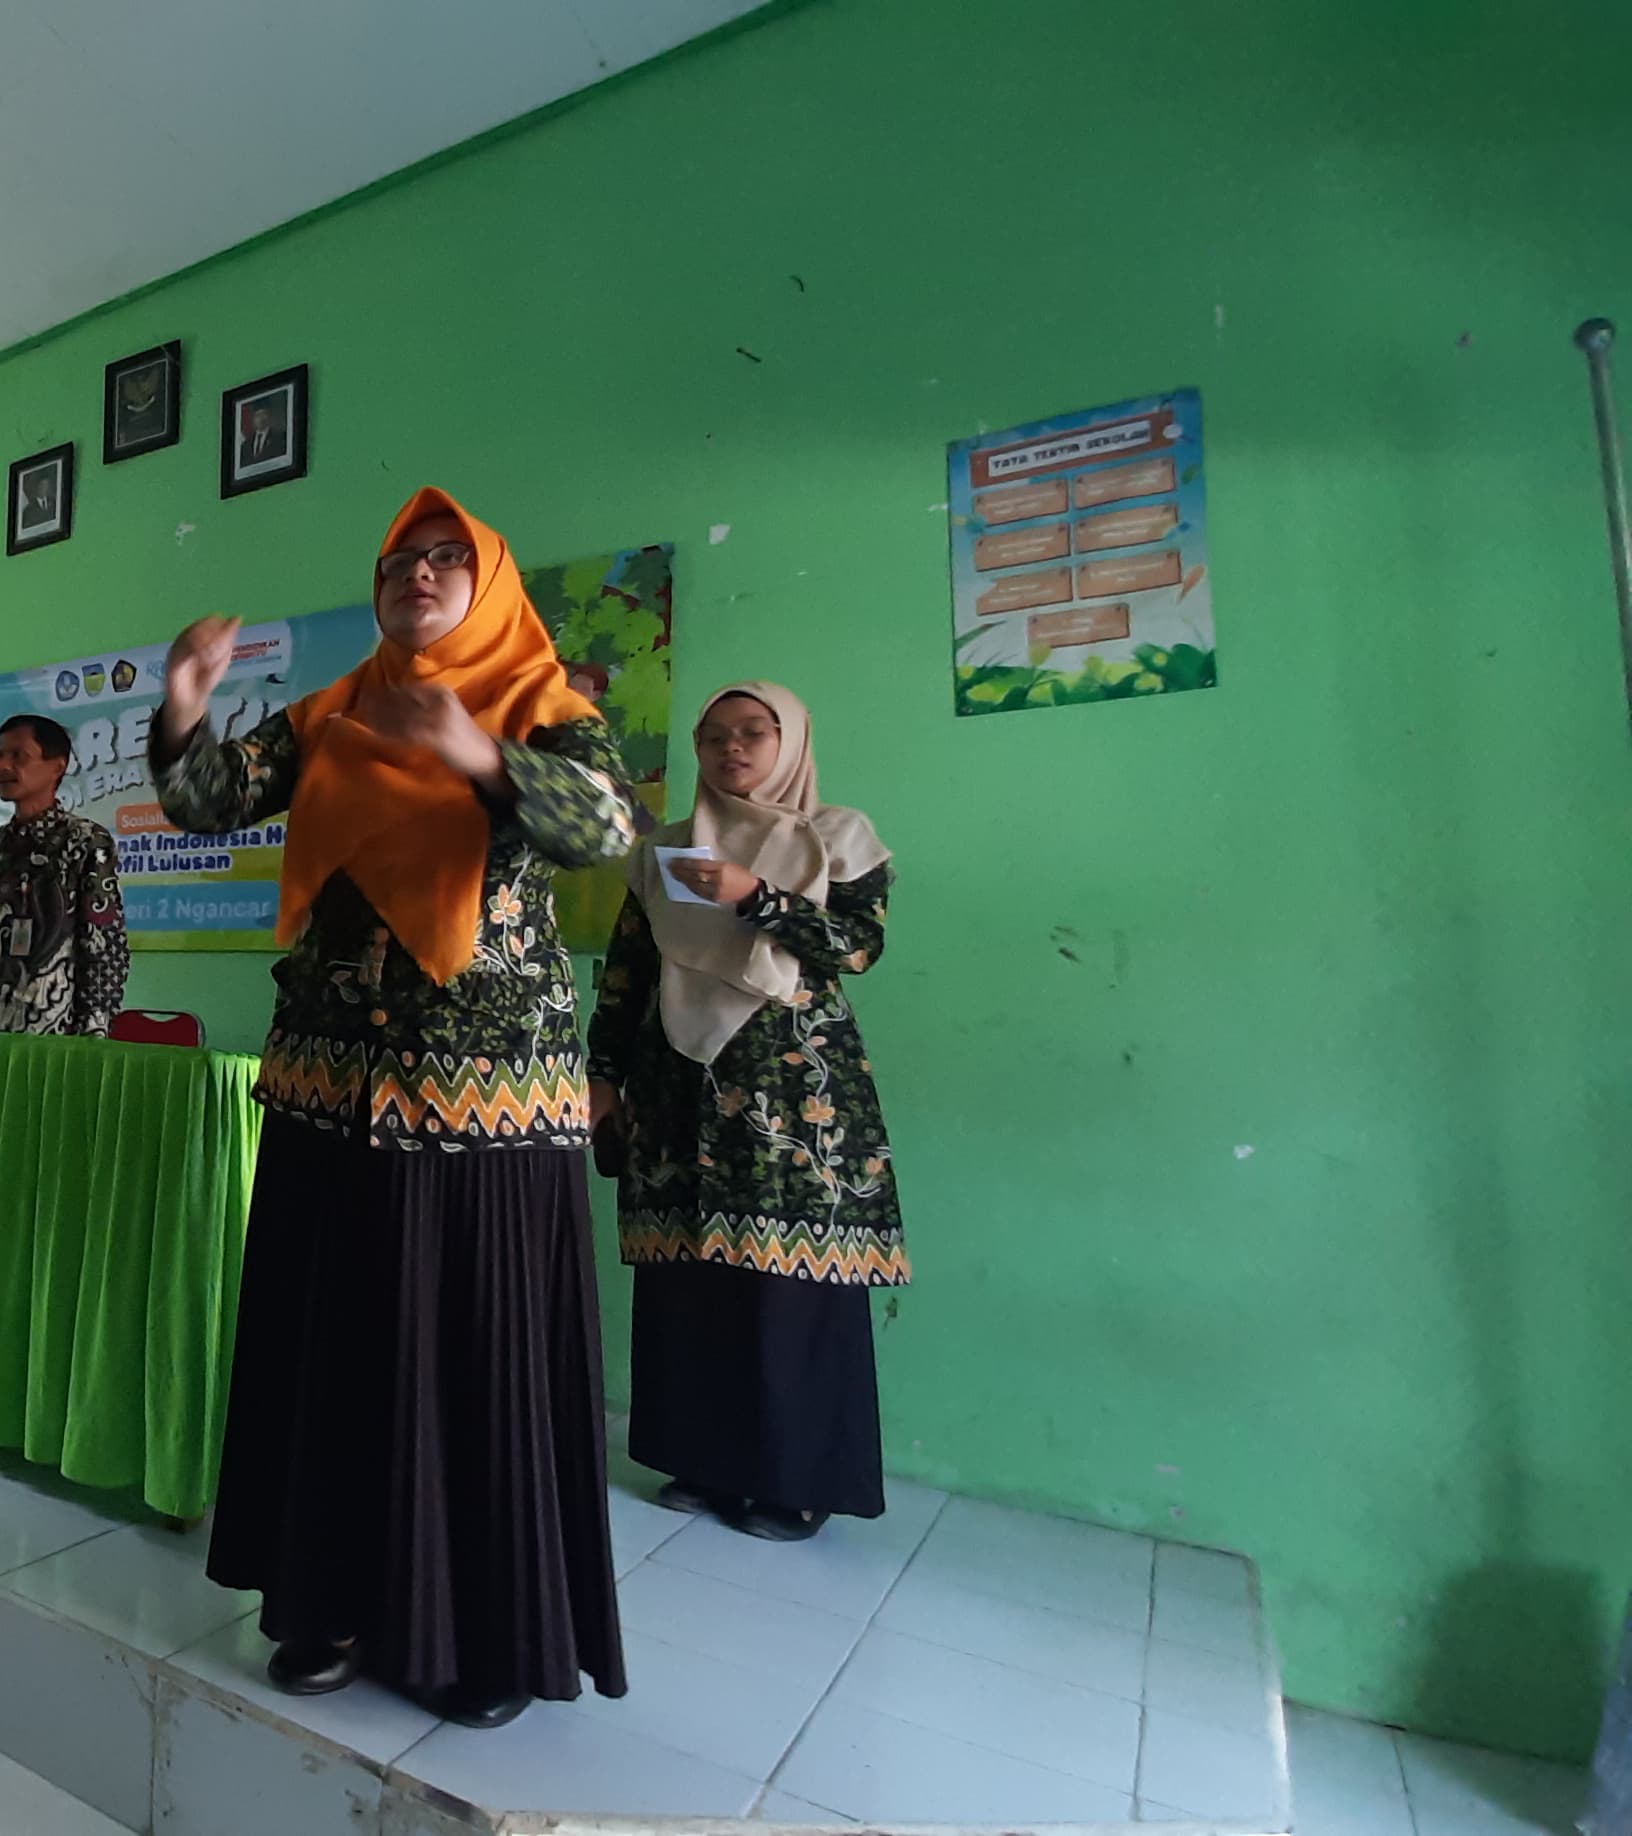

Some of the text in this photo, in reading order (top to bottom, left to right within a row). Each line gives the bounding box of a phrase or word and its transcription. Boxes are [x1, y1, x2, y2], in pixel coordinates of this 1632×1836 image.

[86, 763, 145, 802] ERA
[117, 834, 152, 854] nak
[156, 830, 261, 853] Indonesia
[147, 853, 231, 873] Lulusan
[126, 898, 269, 924] eri 2 Ngancar
